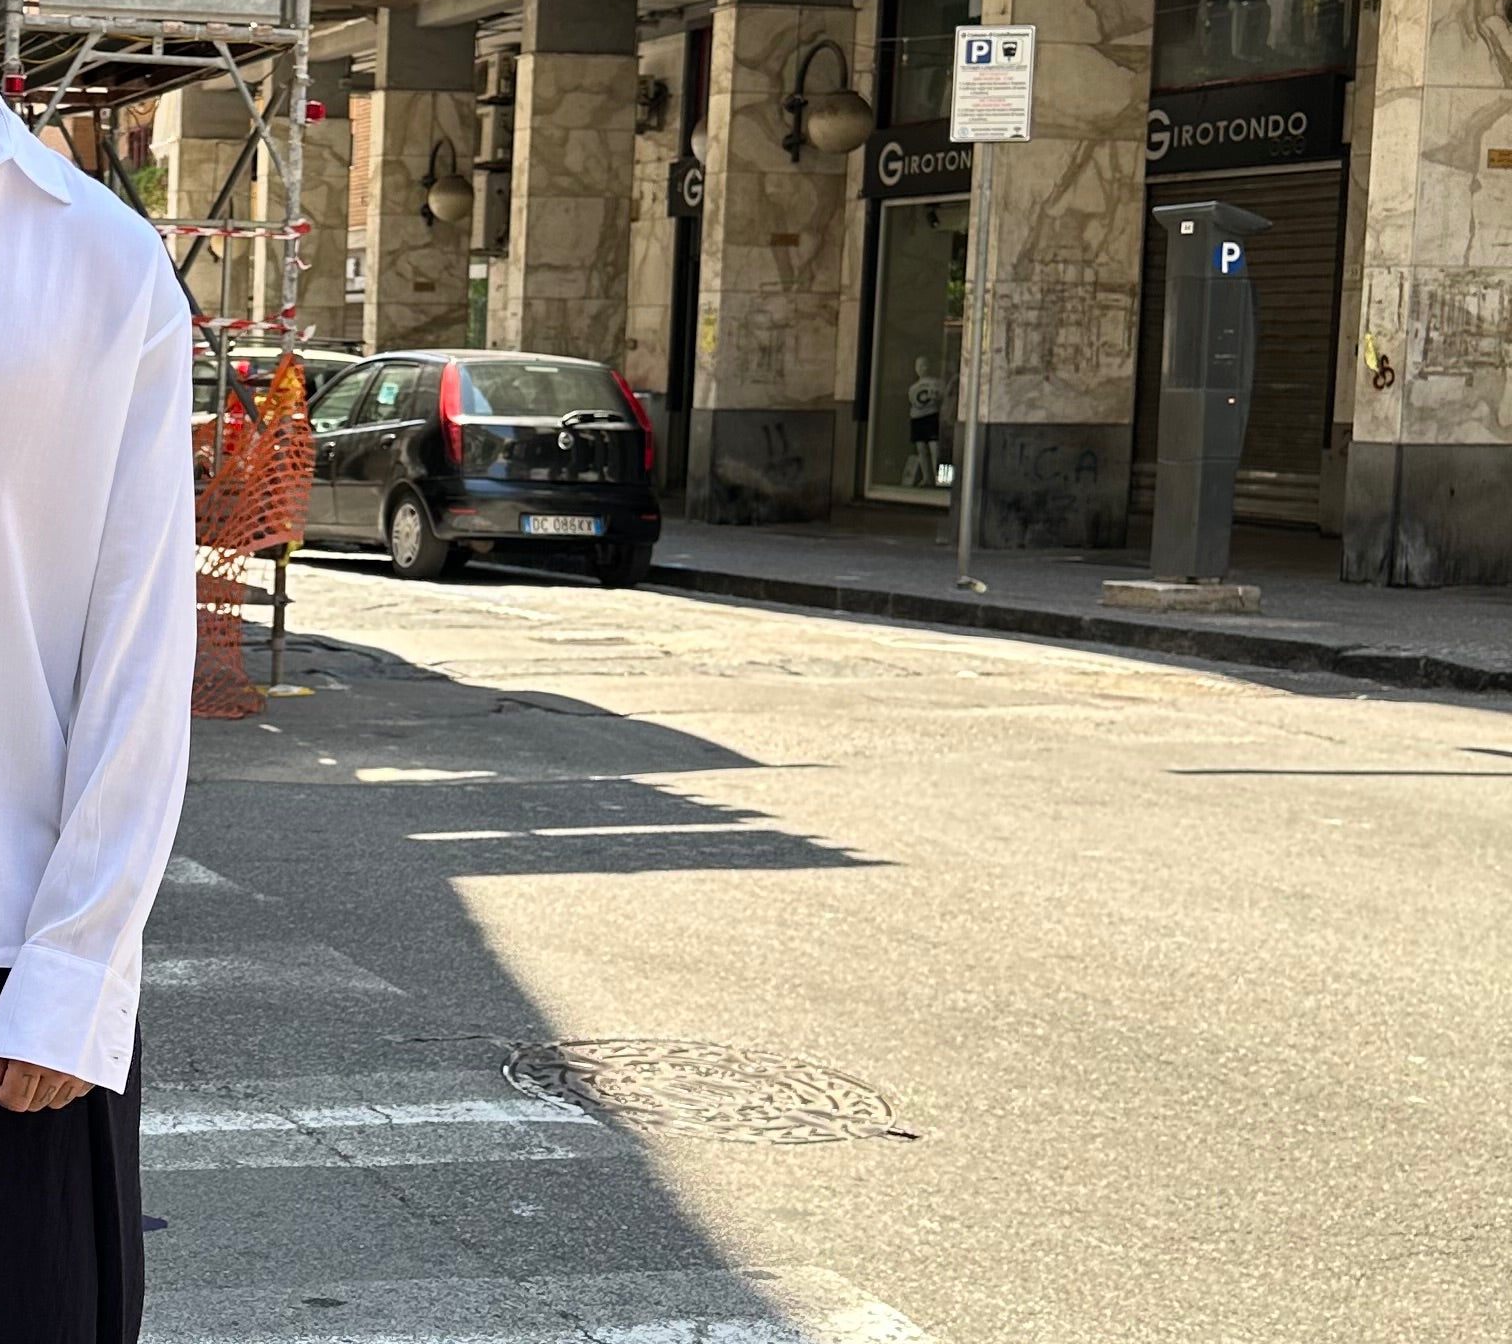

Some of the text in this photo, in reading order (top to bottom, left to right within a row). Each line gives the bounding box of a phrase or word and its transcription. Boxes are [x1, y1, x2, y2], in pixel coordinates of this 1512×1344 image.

[1146, 109, 1308, 161] GIROTONDO
[879, 141, 971, 187] GIROTON
[683, 168, 703, 207] G
[532, 517, 548, 531] DC
